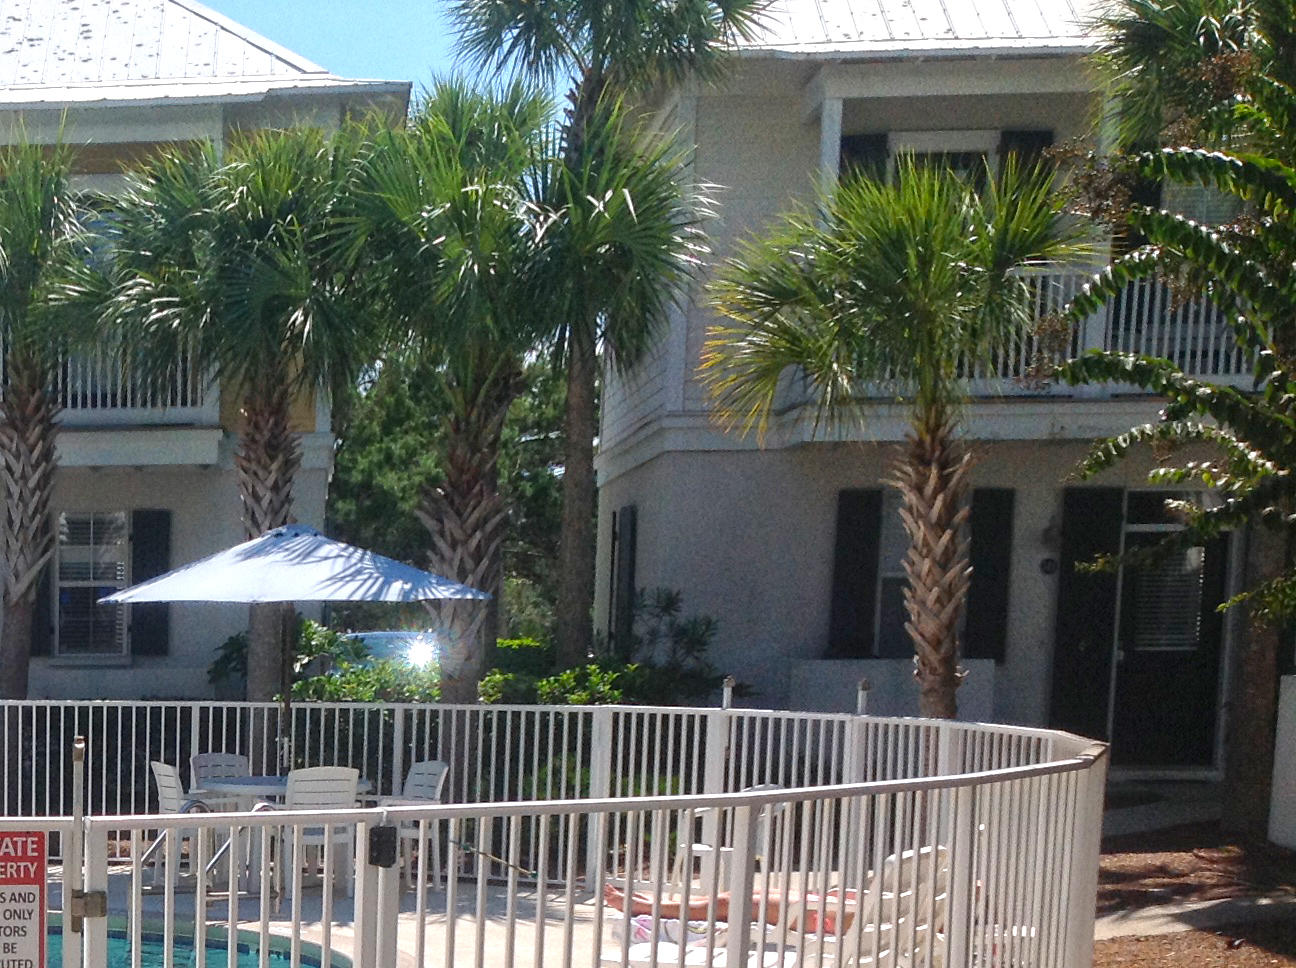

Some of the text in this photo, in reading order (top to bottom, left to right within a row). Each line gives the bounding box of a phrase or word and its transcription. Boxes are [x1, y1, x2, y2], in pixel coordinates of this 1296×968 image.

[9, 892, 36, 903] AND
[3, 909, 34, 920] ONLY
[3, 943, 17, 954] BE
